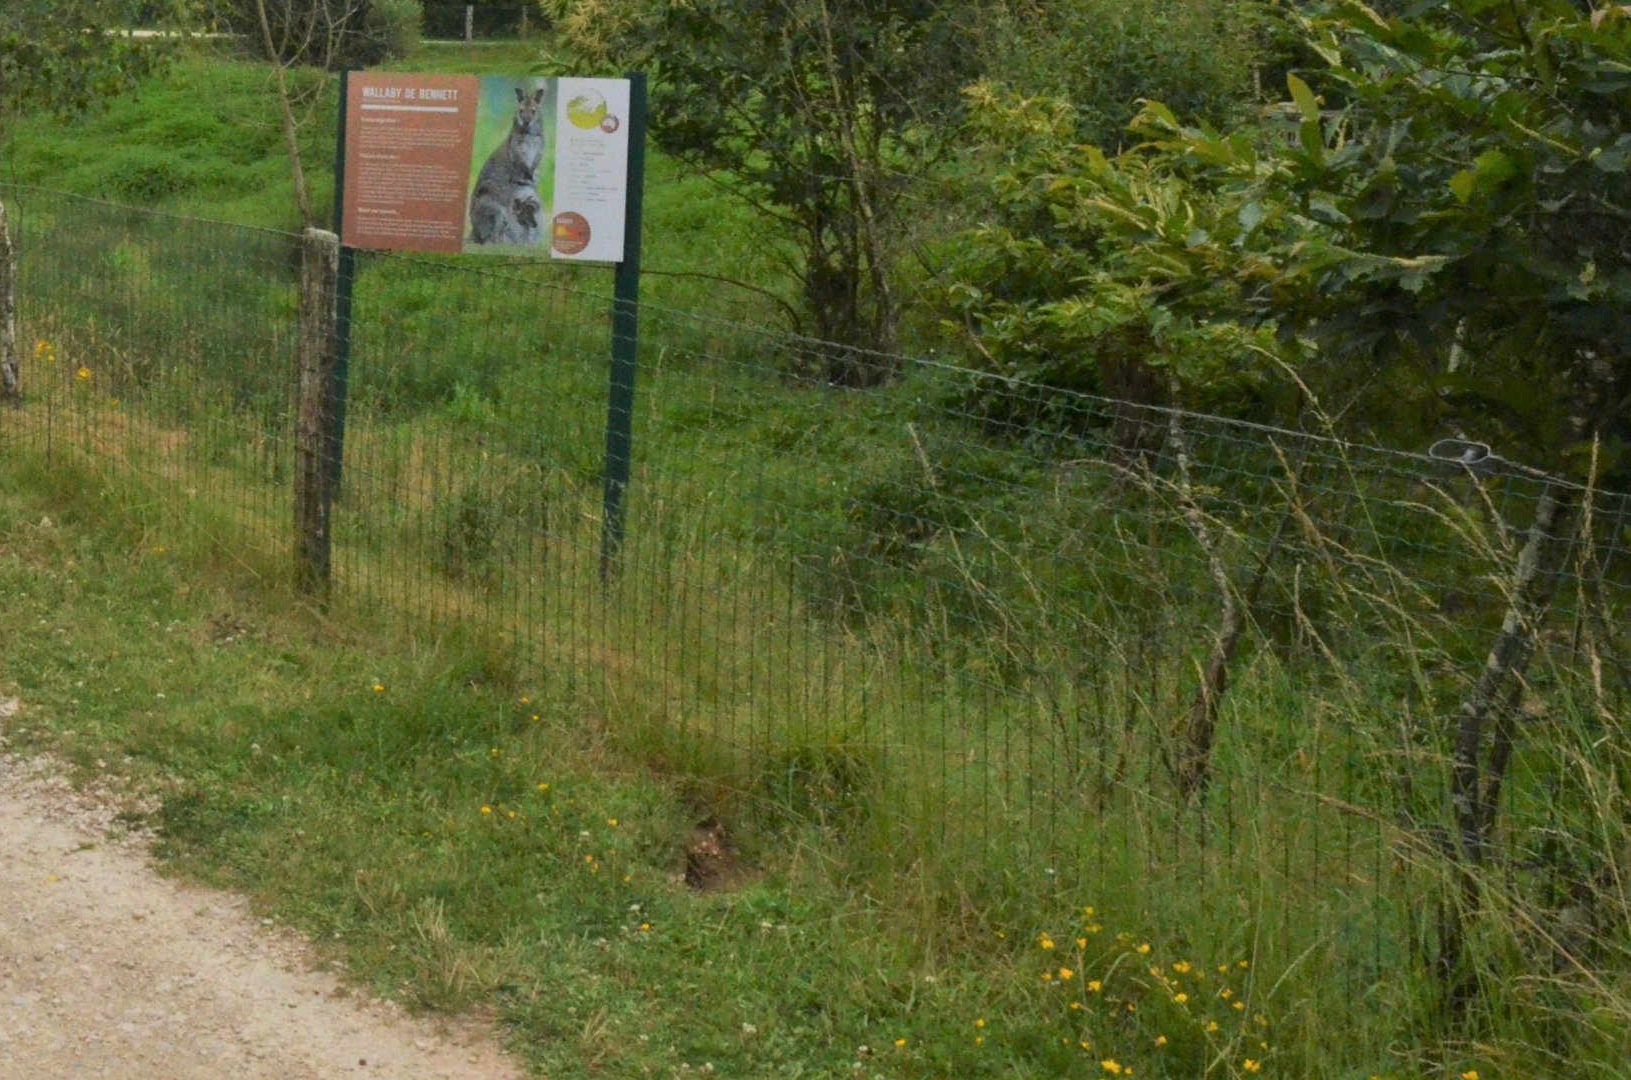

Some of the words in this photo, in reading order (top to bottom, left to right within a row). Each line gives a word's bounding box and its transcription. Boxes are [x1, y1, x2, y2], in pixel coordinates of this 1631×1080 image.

[362, 87, 401, 98] WALLABY
[405, 88, 416, 99] DE
[419, 89, 458, 100] BENNETT
